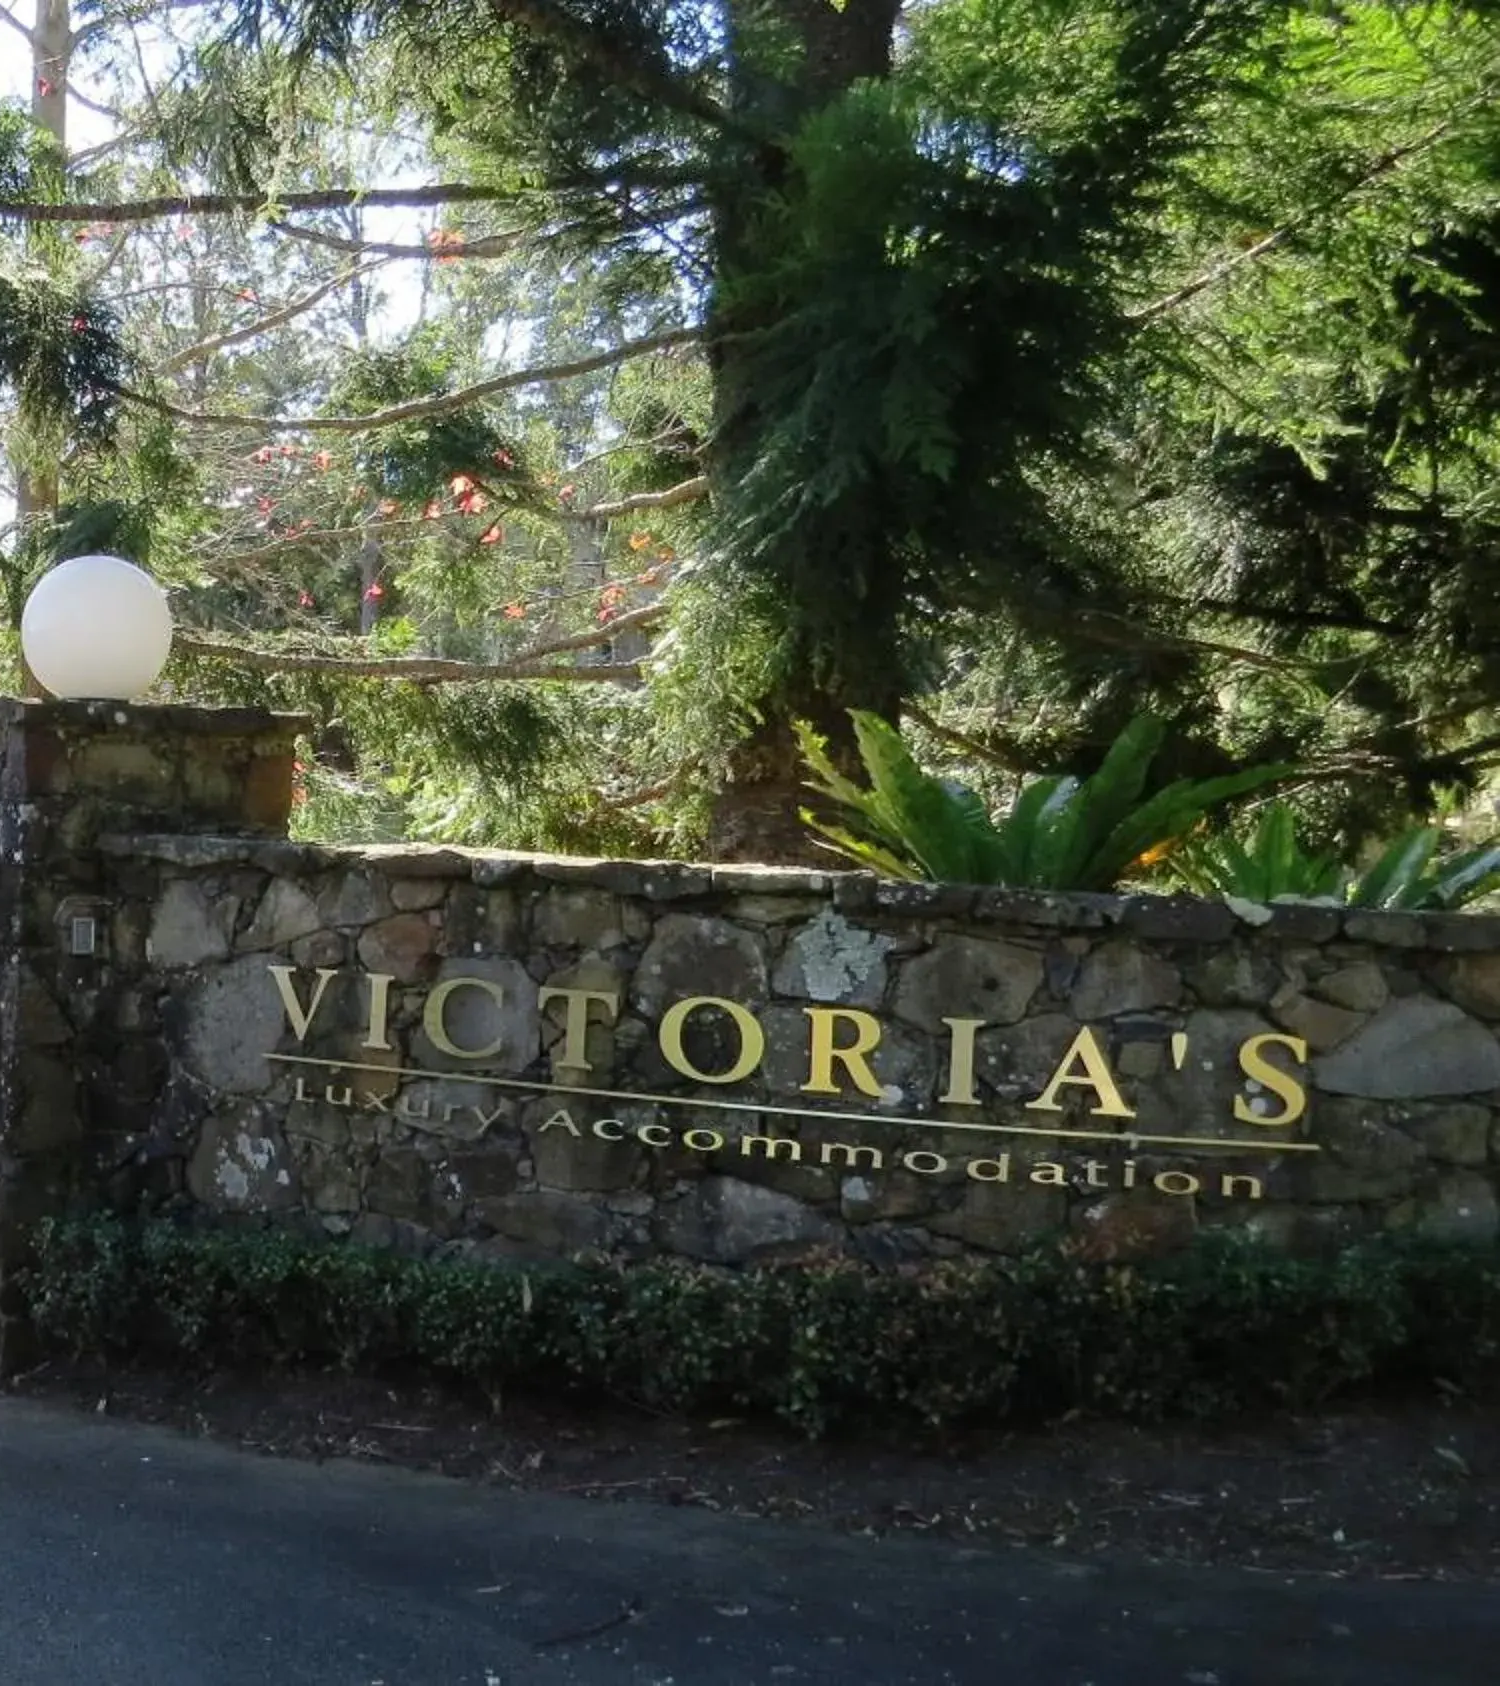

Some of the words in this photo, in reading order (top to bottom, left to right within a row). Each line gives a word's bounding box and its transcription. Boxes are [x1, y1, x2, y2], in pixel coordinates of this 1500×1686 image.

[268, 965, 1307, 1126] VICTORIA'S
[296, 1078, 504, 1134] Luxury
[539, 1109, 1263, 1198] Accommodation
